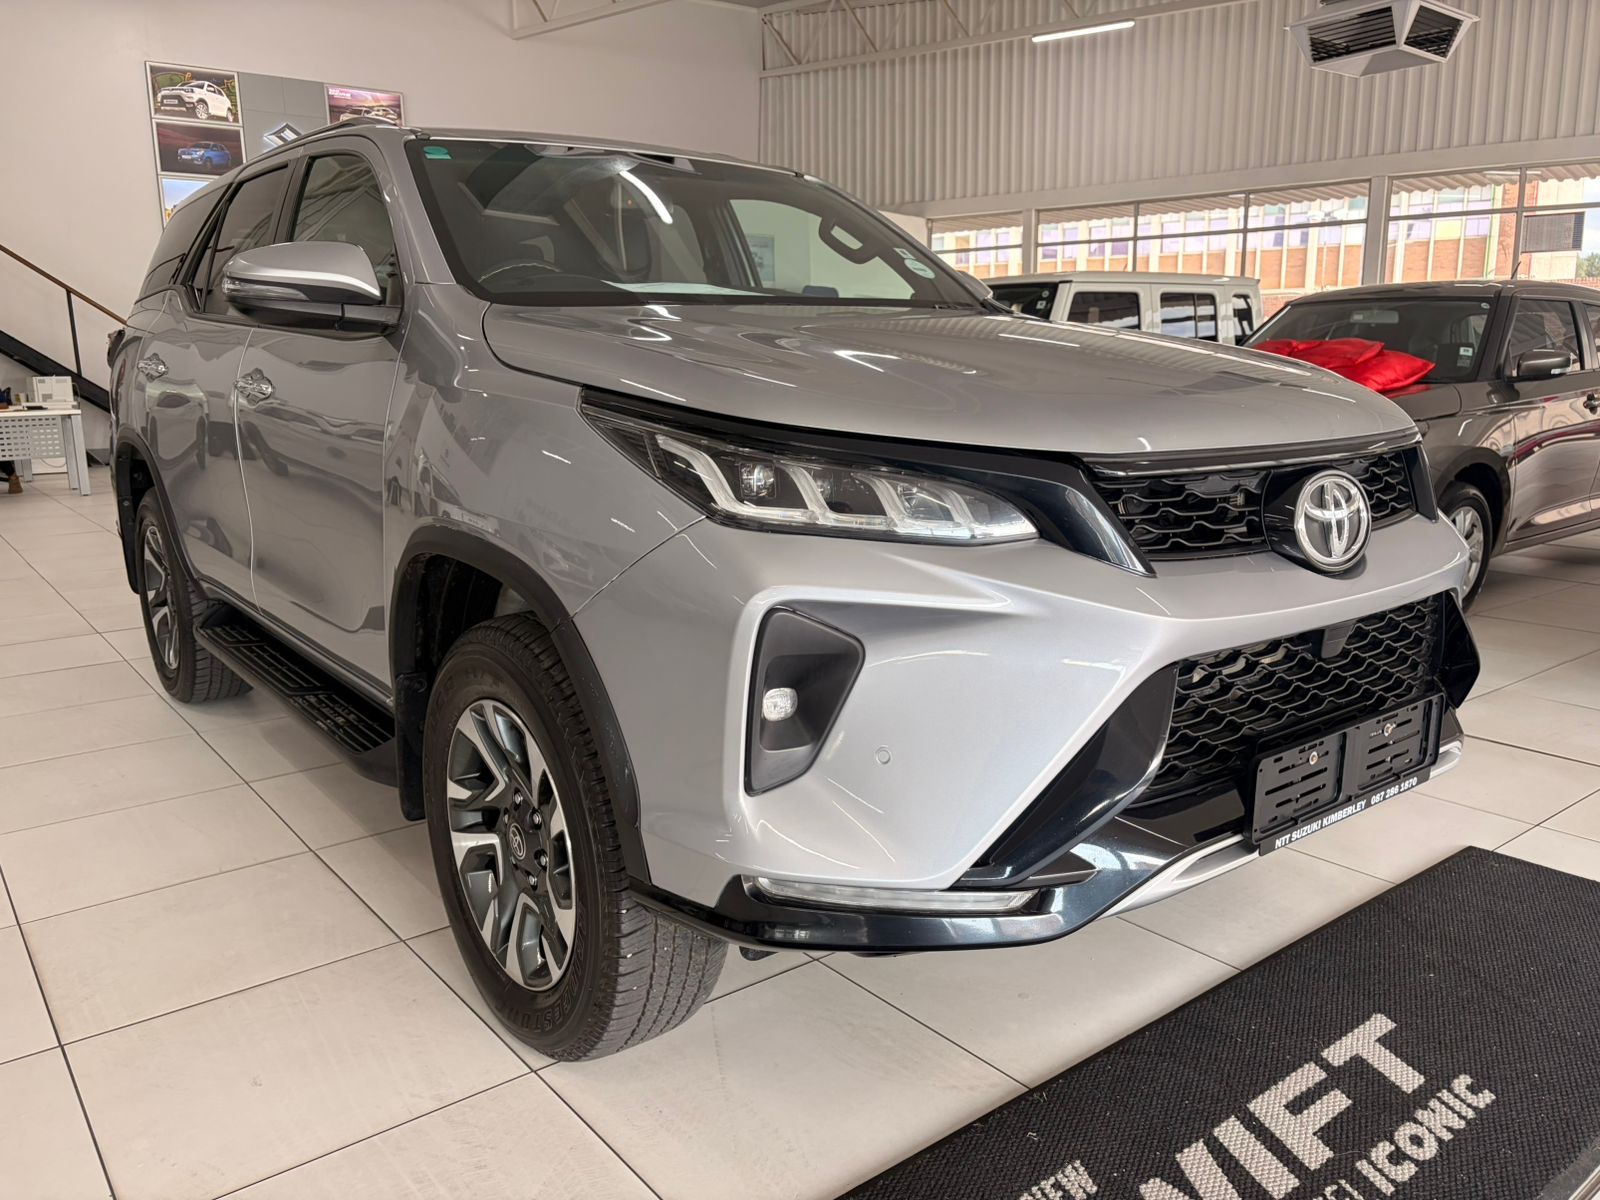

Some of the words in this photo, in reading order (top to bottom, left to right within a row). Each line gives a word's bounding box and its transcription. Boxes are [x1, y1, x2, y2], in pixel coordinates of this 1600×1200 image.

[1275, 834, 1291, 849] NTT
[1291, 820, 1321, 841] SUZUKI
[1322, 800, 1366, 827] KIMBERLEY
[1355, 1074, 1496, 1197] ICONIC
[1018, 1160, 1098, 1200] EW
